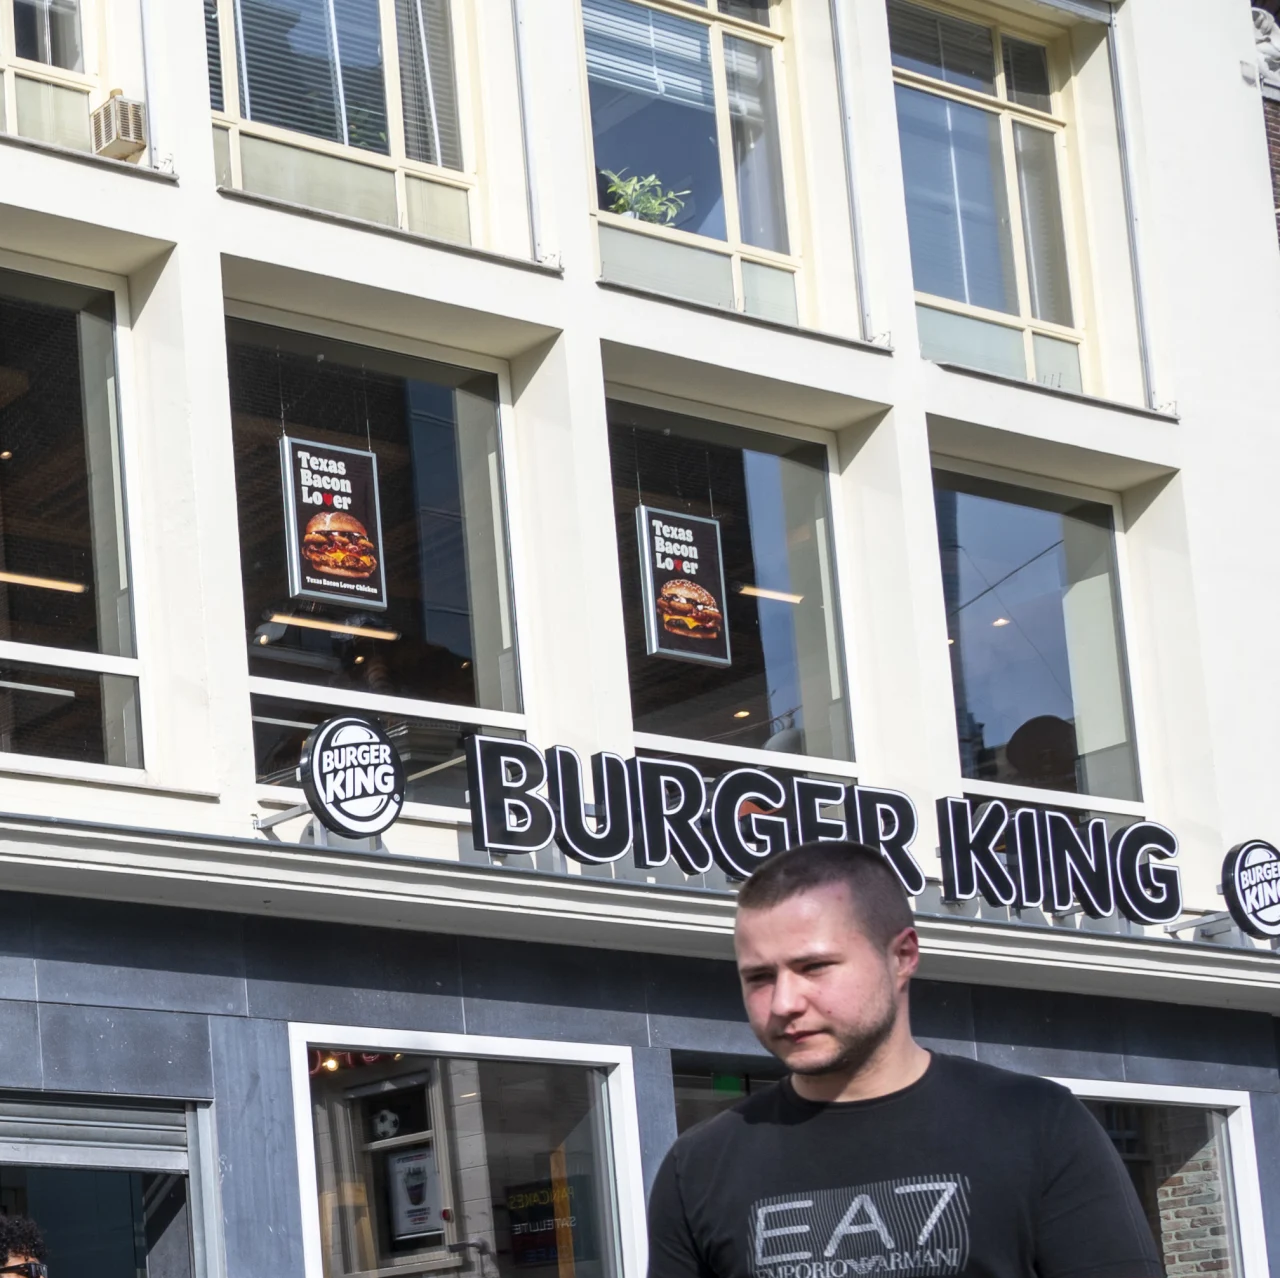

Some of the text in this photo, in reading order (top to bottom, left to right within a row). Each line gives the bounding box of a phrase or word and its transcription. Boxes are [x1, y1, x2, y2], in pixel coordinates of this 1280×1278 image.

[297, 451, 347, 475] Texas
[300, 468, 352, 493] Bacon
[652, 519, 694, 543] Texas
[654, 536, 699, 560] Bacon
[306, 575, 322, 586] Texas
[323, 579, 340, 588] Bacon
[340, 582, 355, 590] Lover
[356, 584, 378, 594] Chicken
[322, 744, 392, 774] BURGER
[325, 763, 395, 804] KING
[468, 734, 1183, 924] BURGER KING
[1240, 861, 1280, 890] BURGE
[1244, 879, 1280, 915] KIN
[755, 1181, 958, 1266] EA7
[876, 1247, 960, 1273] ARMANI
